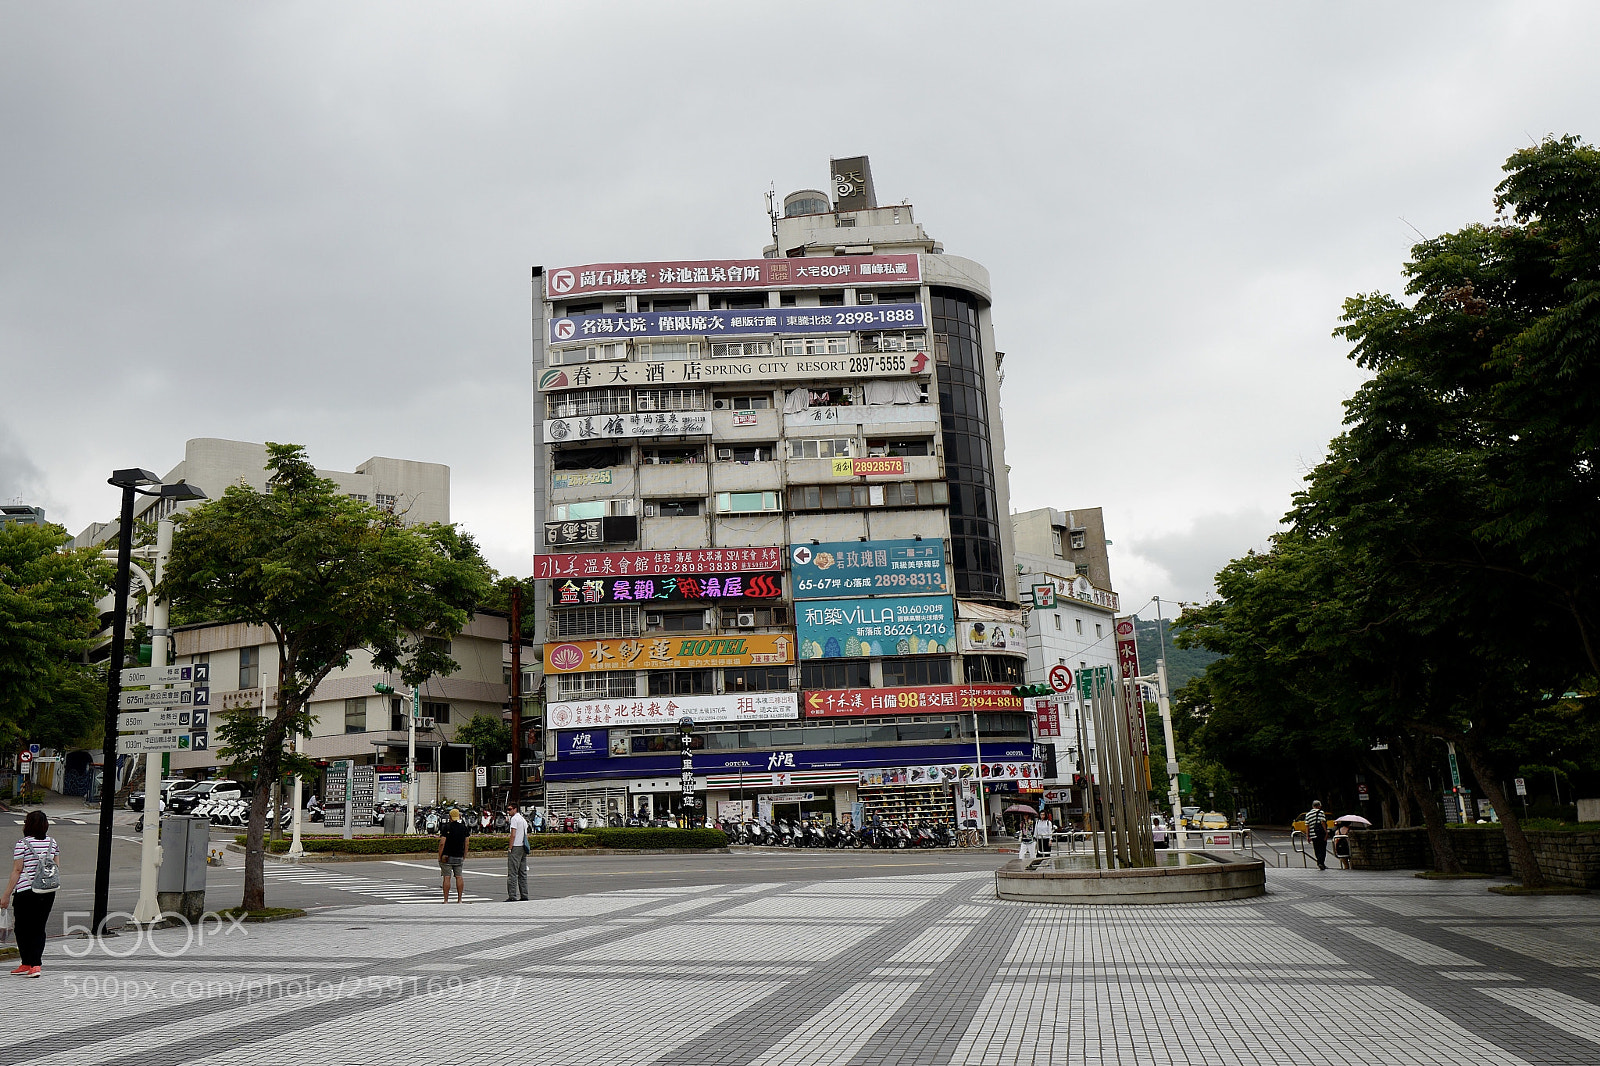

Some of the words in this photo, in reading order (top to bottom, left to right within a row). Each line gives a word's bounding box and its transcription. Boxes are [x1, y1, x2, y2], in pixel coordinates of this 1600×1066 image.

[835, 309, 915, 326] 2898-1888
[705, 364, 752, 379] SPRING
[759, 363, 790, 377] CITY
[796, 361, 847, 376] RESORT
[849, 356, 907, 374] 2897-5555
[681, 422, 704, 433] Hotel
[854, 460, 904, 474] 28928578
[541, 555, 650, 578] 水美溫泉會館
[654, 553, 671, 563] 住宿
[726, 549, 741, 562] SPA
[653, 562, 739, 574] 02-2898-3838
[798, 578, 842, 591] 65-67坪
[874, 572, 942, 588] 2898-8313
[884, 623, 946, 638] 8626-1216
[677, 638, 749, 657] HOTEL
[126, 695, 145, 705] 675m
[737, 696, 757, 714] 租
[960, 696, 1022, 708] 2894-8818
[613, 700, 680, 719] 北投教會
[1059, 791, 1068, 801] P
